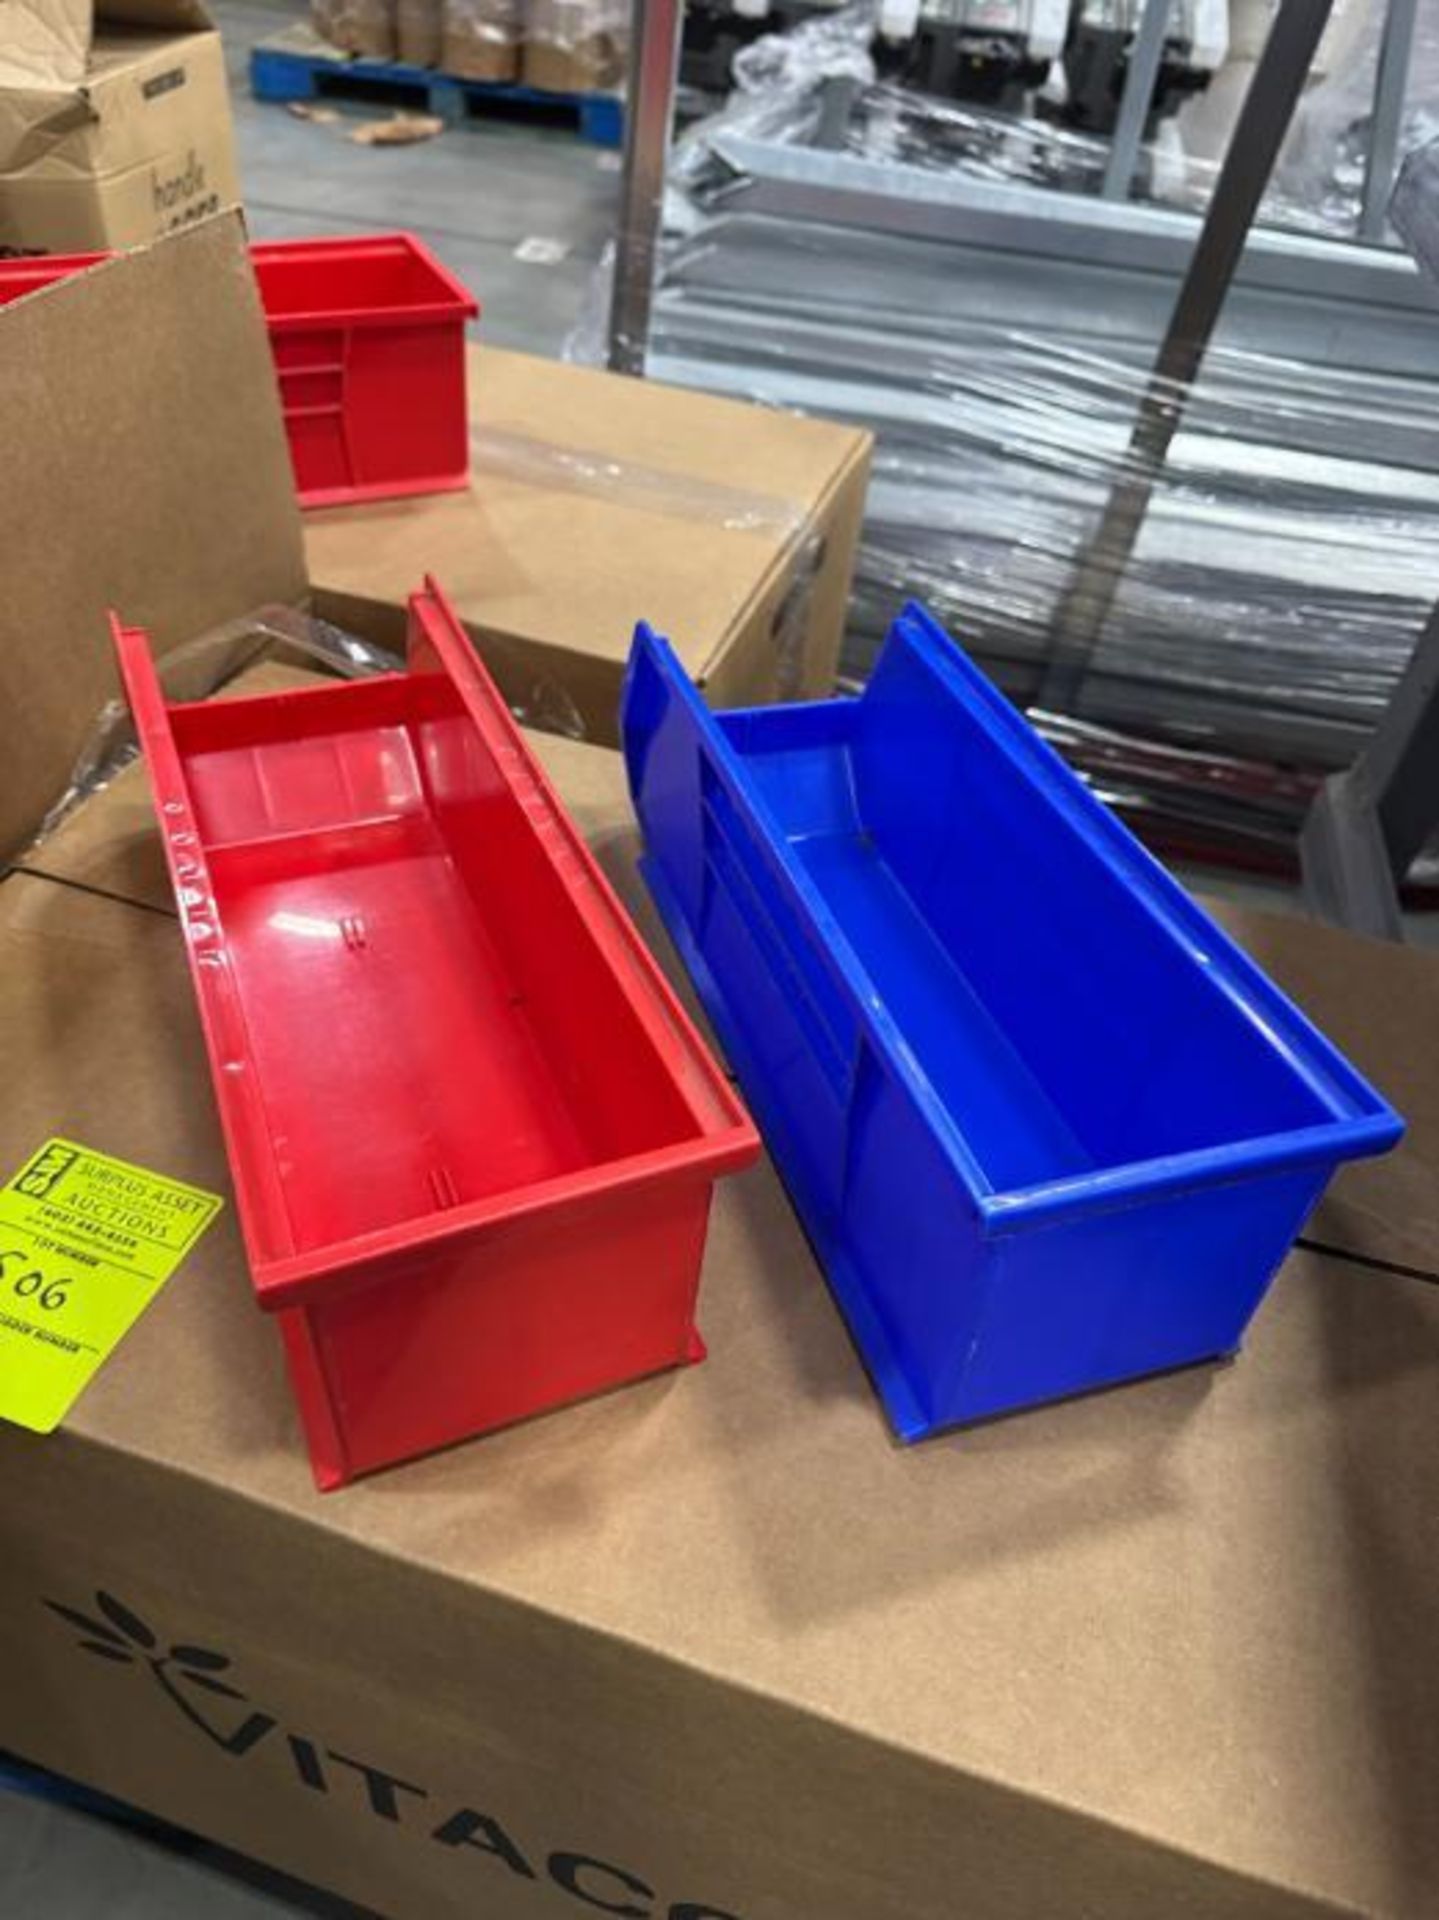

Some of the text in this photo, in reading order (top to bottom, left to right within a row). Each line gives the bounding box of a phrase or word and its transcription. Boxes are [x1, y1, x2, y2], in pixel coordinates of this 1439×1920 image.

[69, 1192, 168, 1239] AUCTIONS
[150, 1189, 203, 1215] ASSET
[147, 1654, 742, 1920] VITAC
